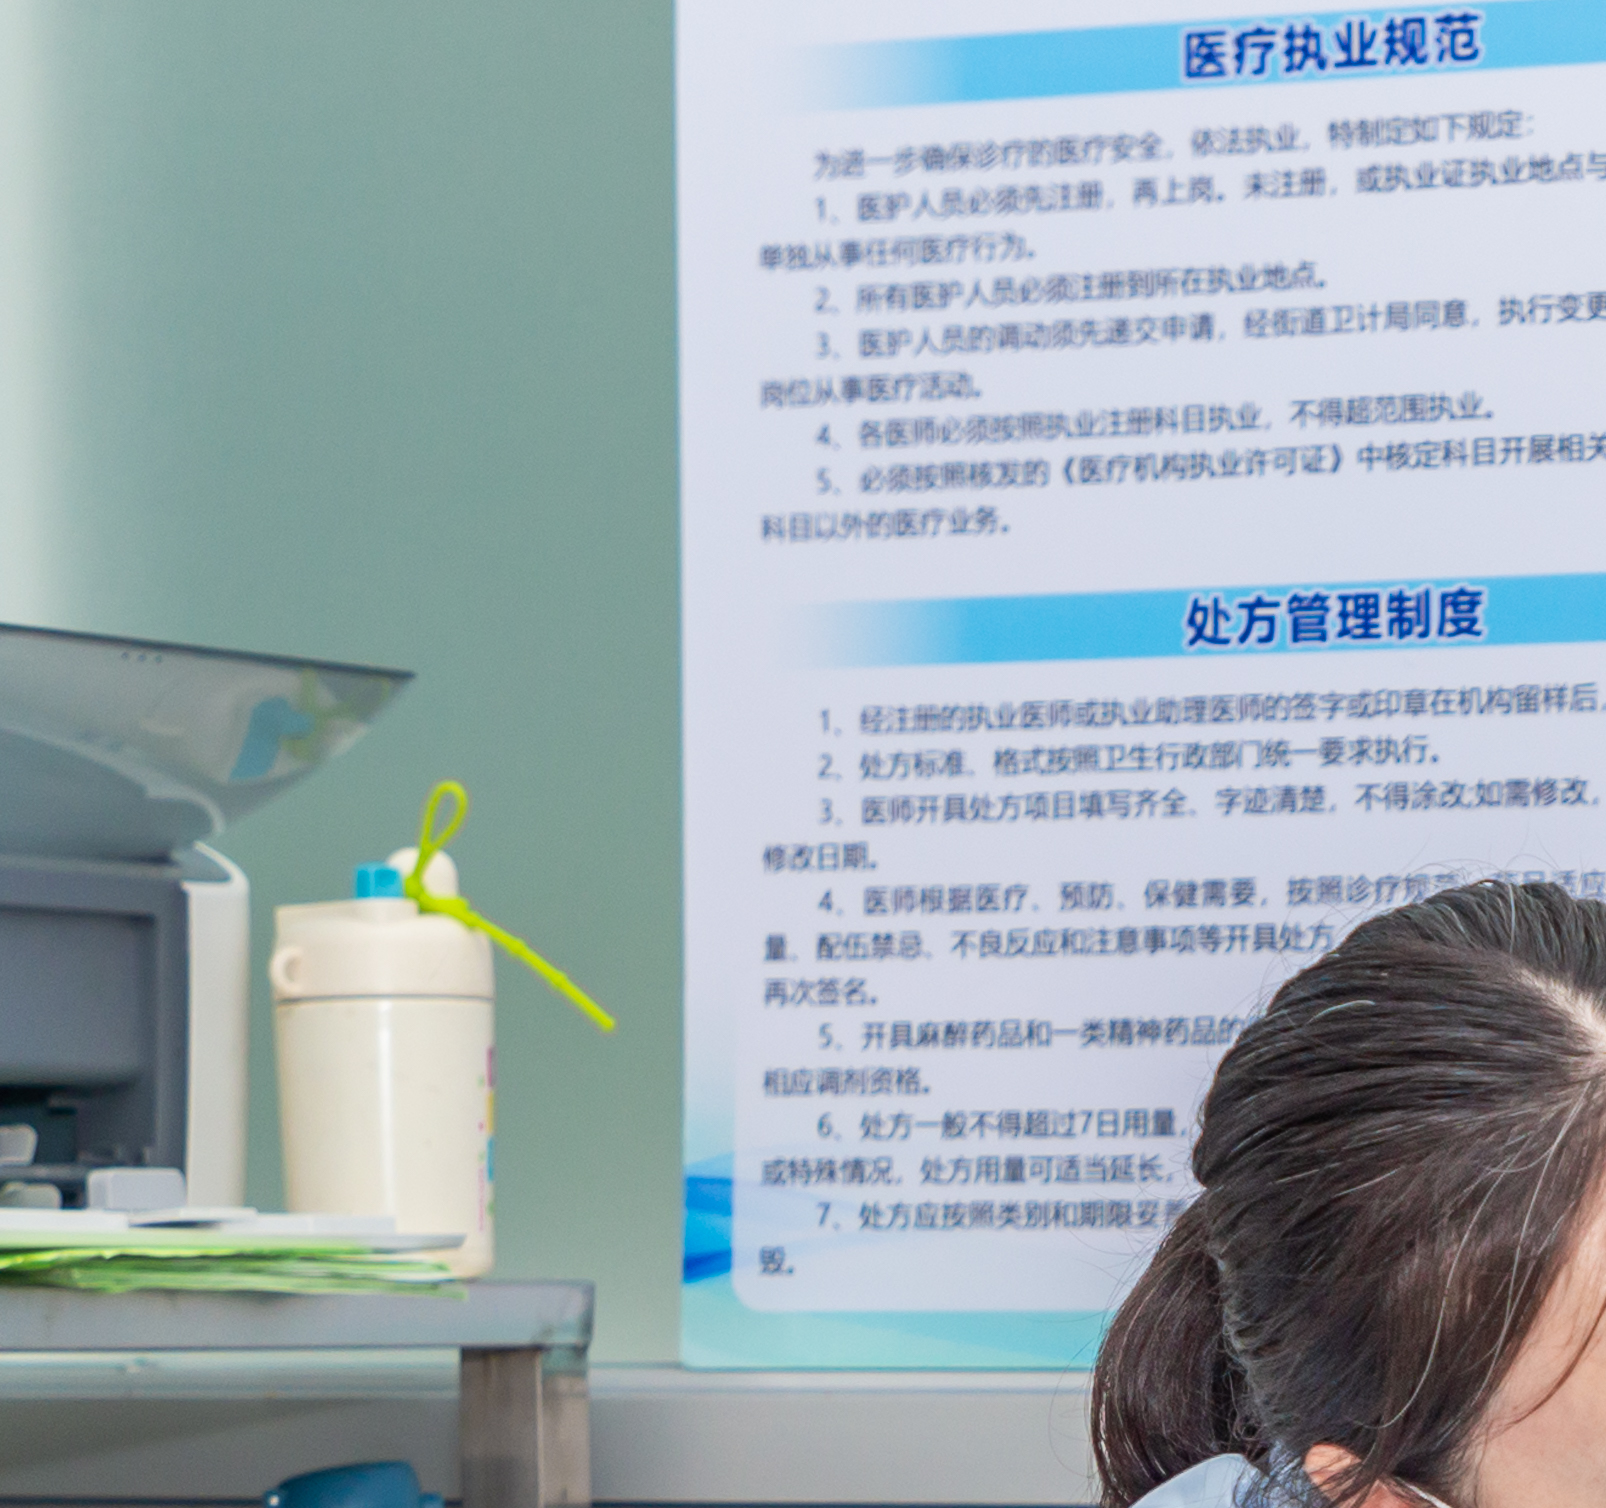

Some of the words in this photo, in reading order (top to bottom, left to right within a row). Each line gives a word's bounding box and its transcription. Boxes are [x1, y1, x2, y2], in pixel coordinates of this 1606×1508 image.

[1184, 13, 1480, 80] 医疗执业规范
[759, 233, 1033, 271] 单独从事任何医疗行为。
[760, 372, 980, 408] 岗位从事医疗活动。
[761, 506, 1009, 543] 科目以外的医疗业务。
[1185, 585, 1484, 647] 处方管理制度
[762, 842, 876, 873] 修改日期。
[764, 978, 877, 1007] 再次签名。
[819, 1018, 1256, 1049] 5、开具麻醉药品和一类精神药品的
[763, 1067, 929, 1097] 相应调剂资格。
